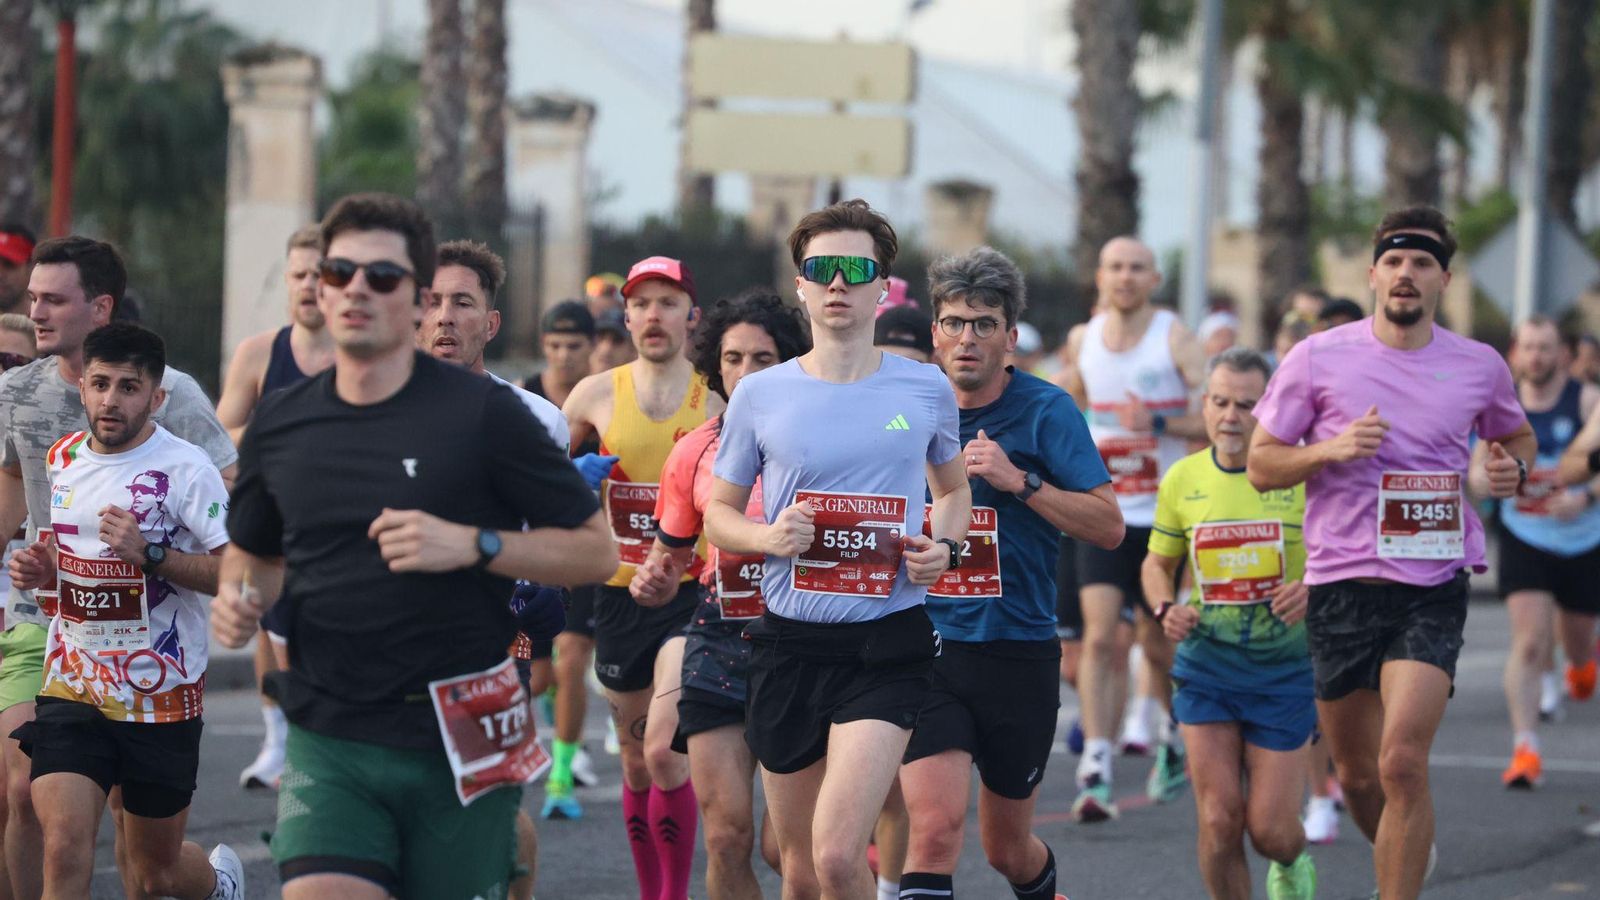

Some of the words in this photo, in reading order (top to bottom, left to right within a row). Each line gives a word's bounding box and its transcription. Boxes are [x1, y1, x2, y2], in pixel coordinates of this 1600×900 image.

[825, 497, 898, 516] GENERALI
[1400, 503, 1454, 520] 13453
[629, 512, 654, 530] 53
[822, 529, 878, 551] 5534
[1215, 525, 1275, 539] GENERALI
[840, 550, 860, 559] FILIP
[73, 559, 135, 578] GENERALI
[868, 572, 890, 580] 42K
[70, 588, 121, 609] 13221
[113, 627, 132, 635] 21K
